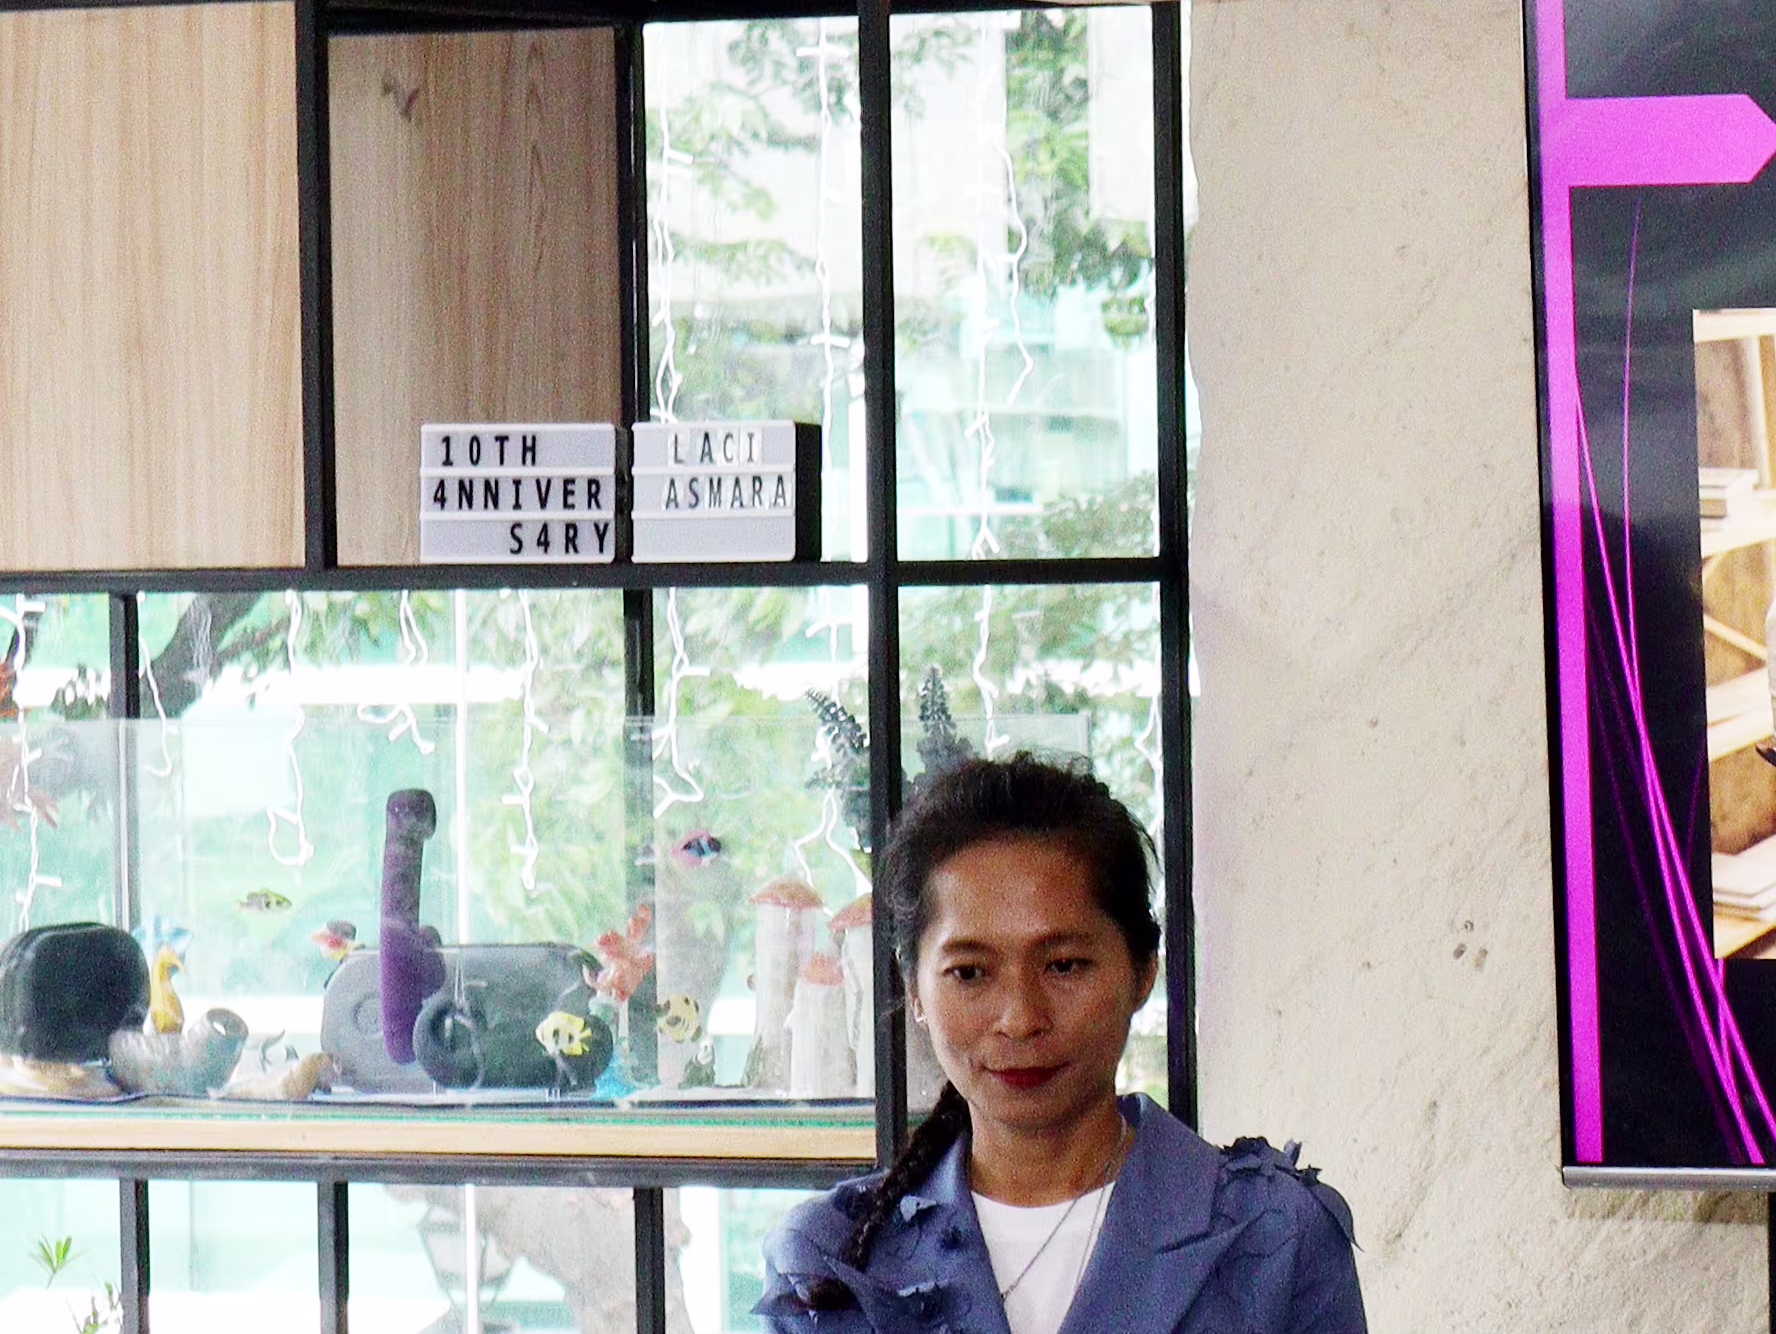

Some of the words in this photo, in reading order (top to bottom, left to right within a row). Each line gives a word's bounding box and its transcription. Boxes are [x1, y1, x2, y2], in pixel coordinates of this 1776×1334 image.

[440, 434, 539, 467] 10TH
[672, 432, 757, 465] LACI
[432, 478, 603, 510] 4NNIVER
[665, 475, 789, 509] ASMARA
[508, 522, 610, 555] S4RY
